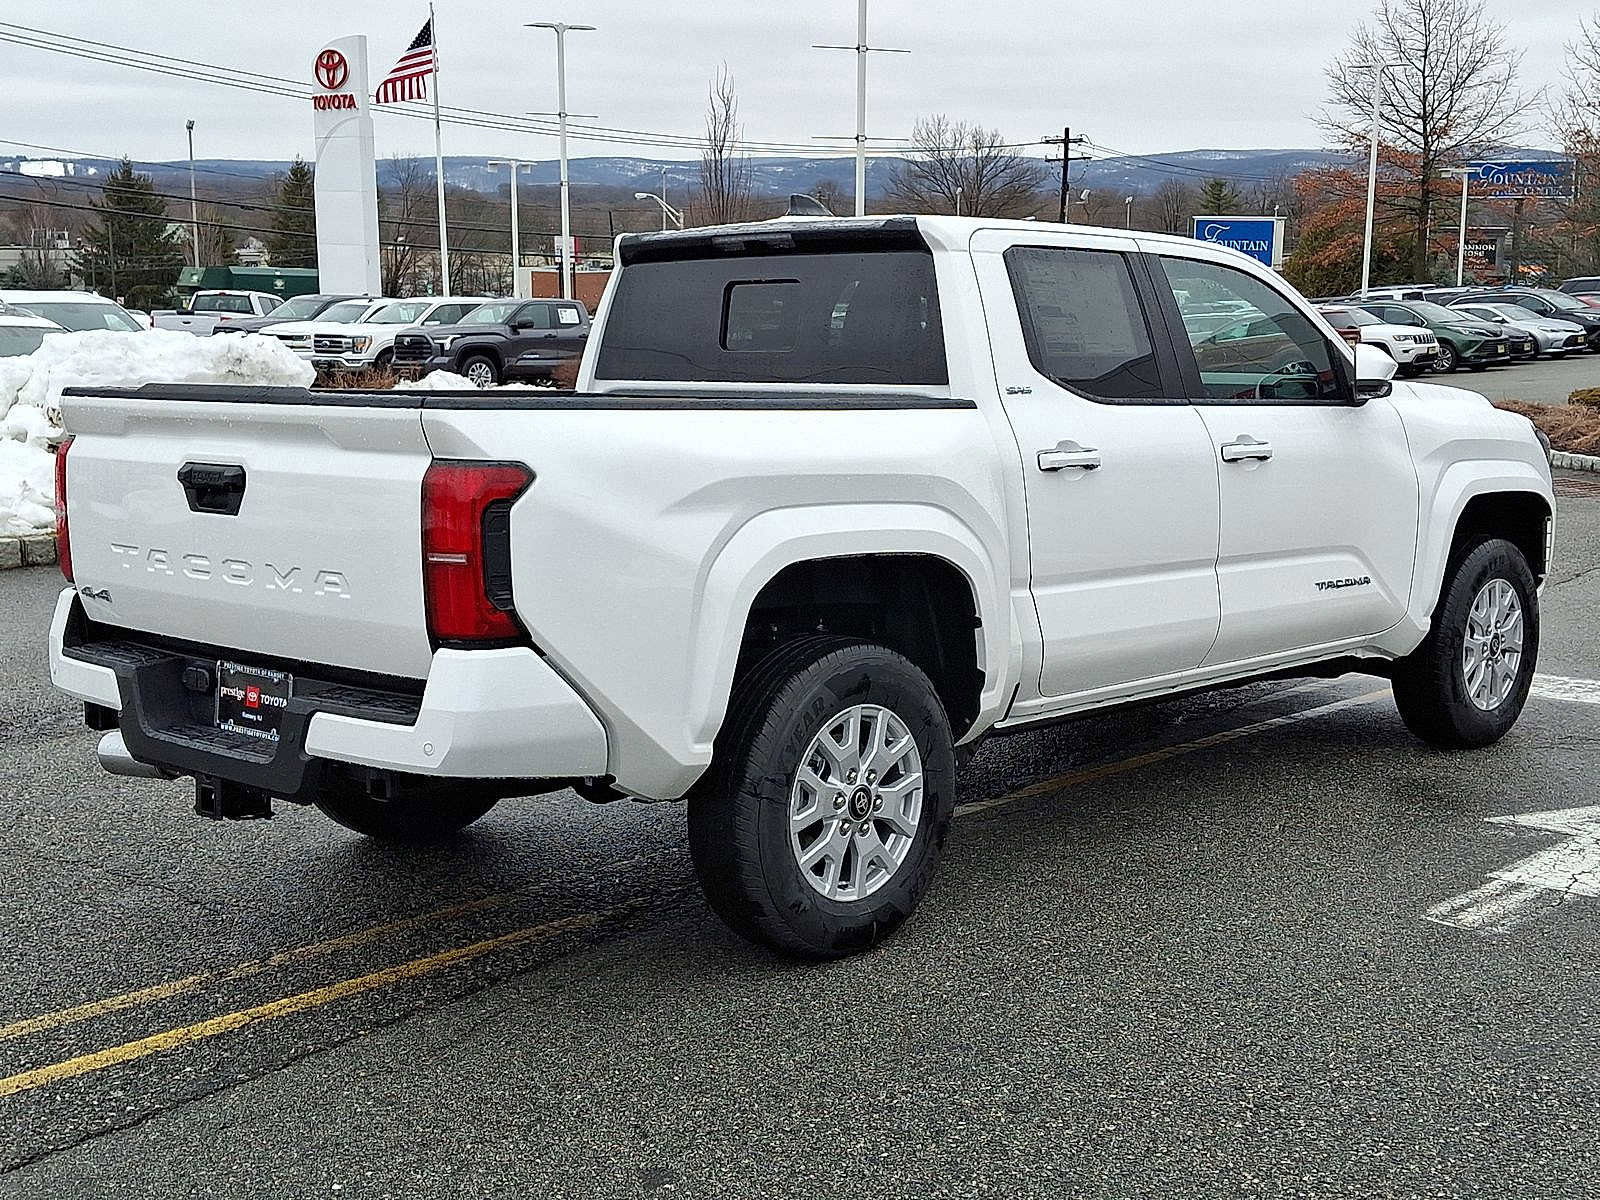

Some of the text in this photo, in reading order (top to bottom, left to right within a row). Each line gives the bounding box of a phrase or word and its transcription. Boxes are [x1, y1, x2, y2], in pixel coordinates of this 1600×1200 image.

[312, 94, 357, 110] TOYOTA
[111, 542, 351, 599] TACOMA
[1315, 576, 1371, 591] TACOMA
[221, 686, 288, 708] prestige TOYOTA
